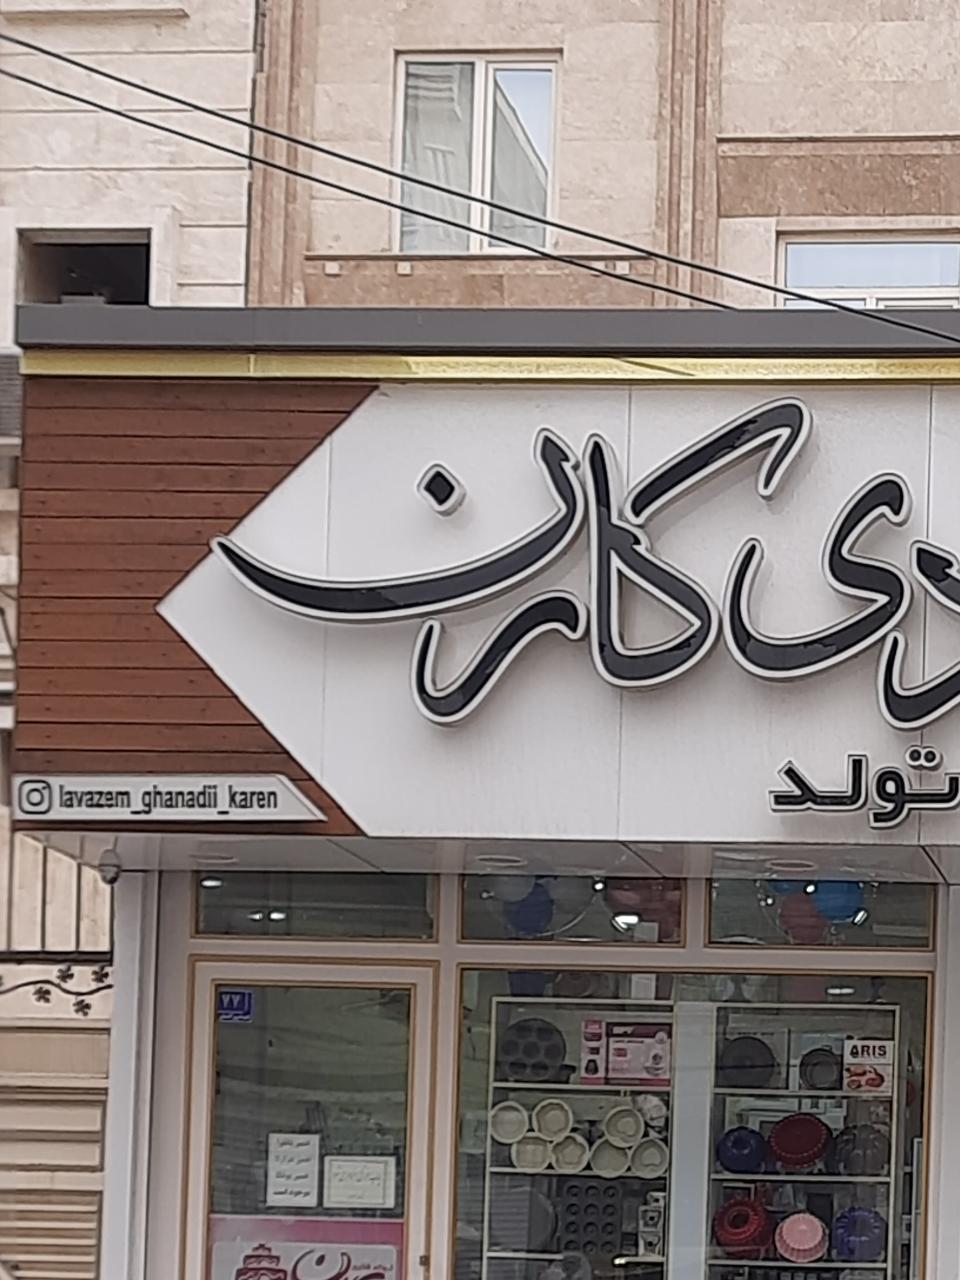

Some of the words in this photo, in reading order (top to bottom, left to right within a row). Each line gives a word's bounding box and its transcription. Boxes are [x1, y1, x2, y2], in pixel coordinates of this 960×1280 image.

[207, 396, 814, 729] کارن
[58, 784, 278, 815] lavazem_ghanadii_karen
[849, 1044, 888, 1058] ARIS
